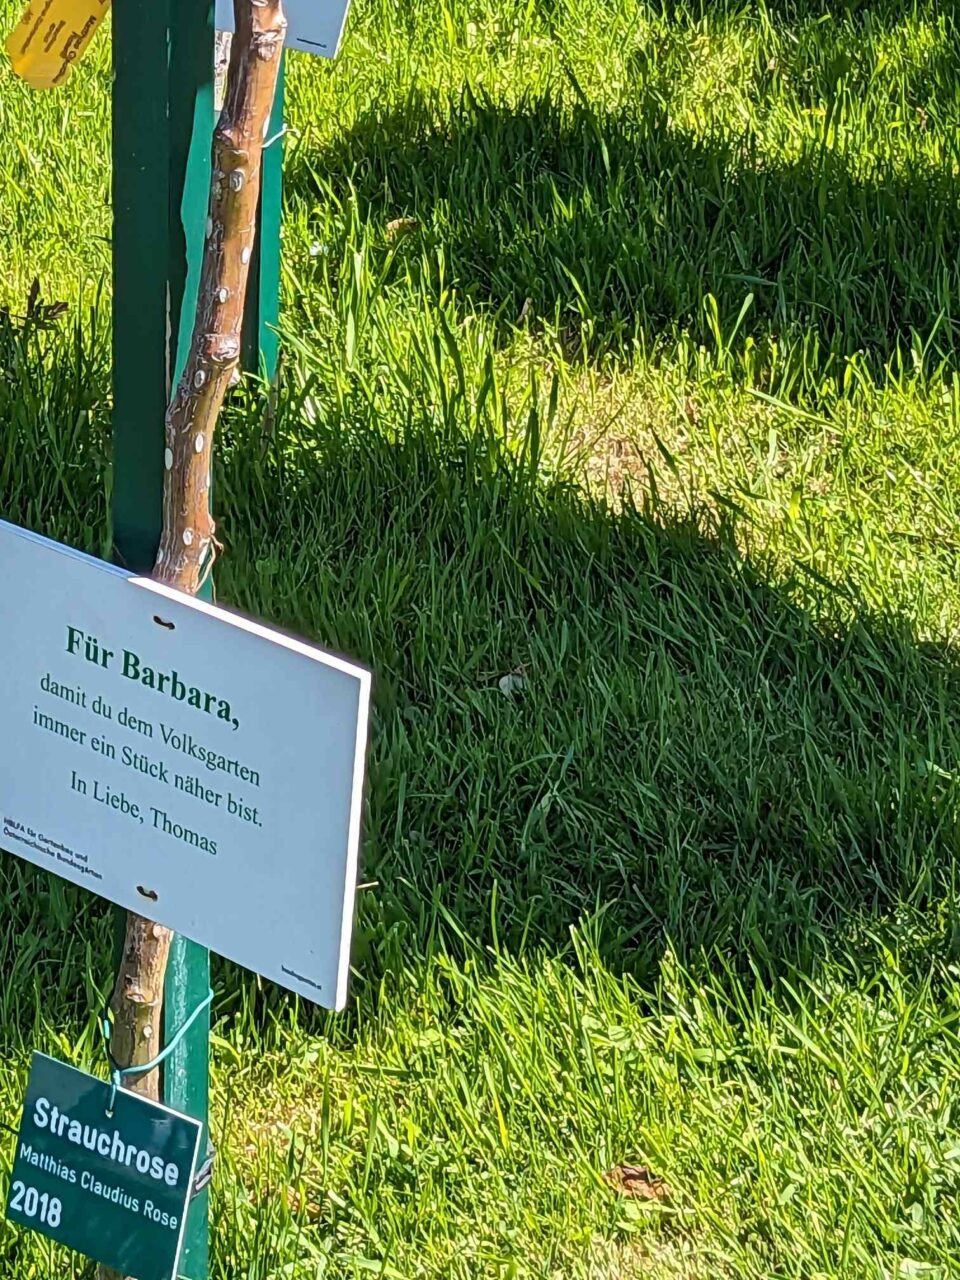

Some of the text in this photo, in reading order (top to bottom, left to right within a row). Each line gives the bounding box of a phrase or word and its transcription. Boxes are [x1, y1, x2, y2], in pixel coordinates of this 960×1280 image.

[65, 625, 241, 730] Für Barbara,
[32, 706, 264, 828] immer ein Stück näher bist.
[40, 673, 261, 787] damit du dem Volksgarten
[71, 770, 218, 856] In Liebe, Thomas
[20, 1142, 178, 1230] Matthias Claudius Rose
[33, 1097, 179, 1187] Strauchrose
[10, 1180, 62, 1228] 2018
